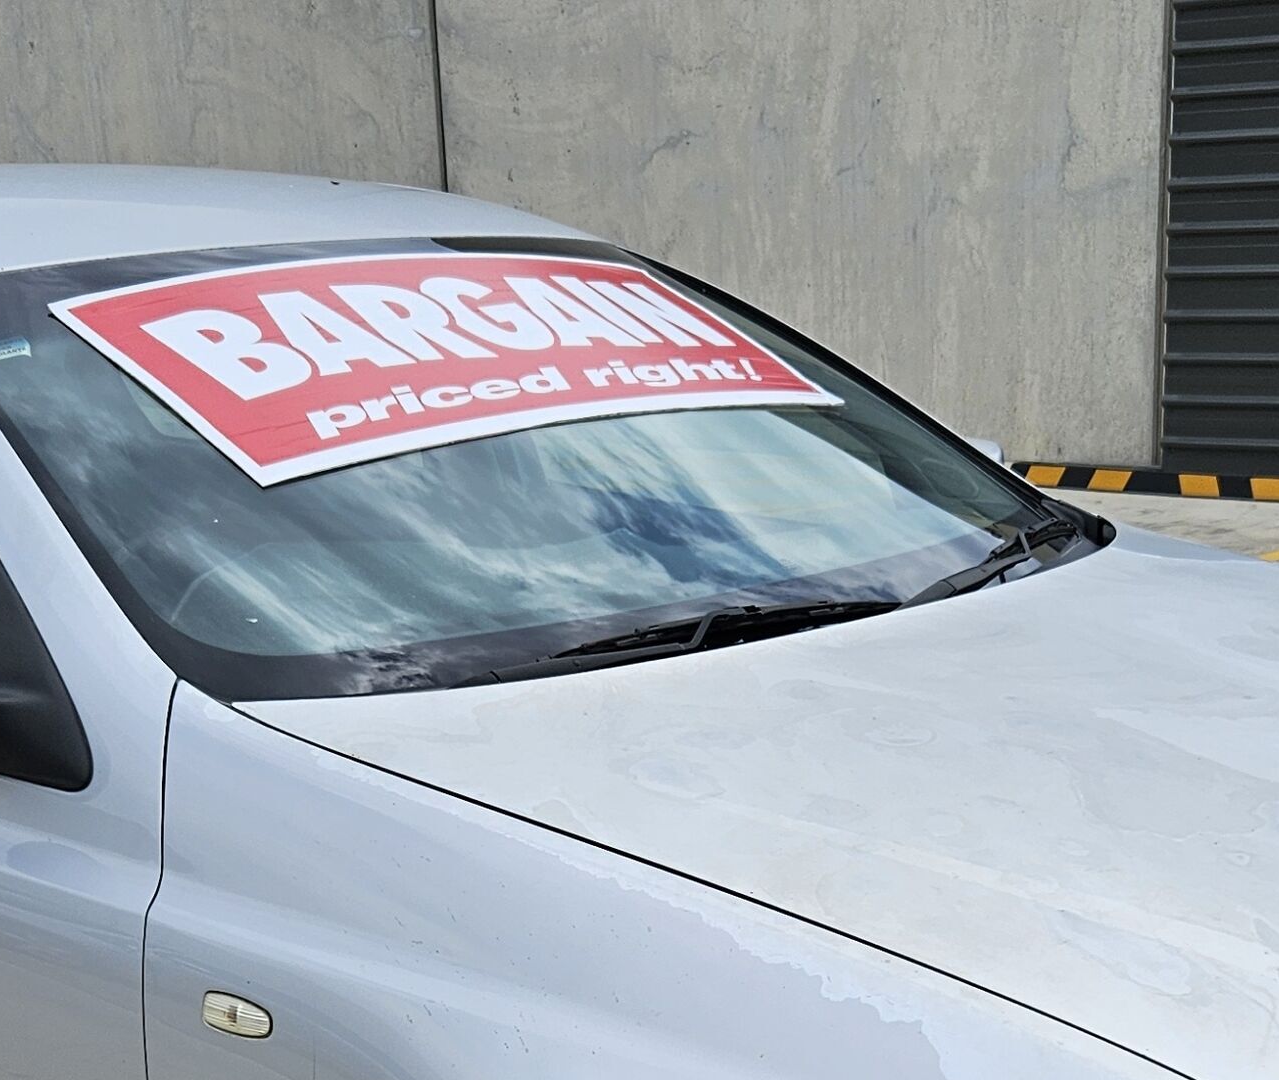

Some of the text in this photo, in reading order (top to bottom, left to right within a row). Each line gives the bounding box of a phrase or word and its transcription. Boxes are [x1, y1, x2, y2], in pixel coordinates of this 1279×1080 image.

[139, 276, 736, 400] BARGAIN
[306, 357, 763, 440] priced right!
